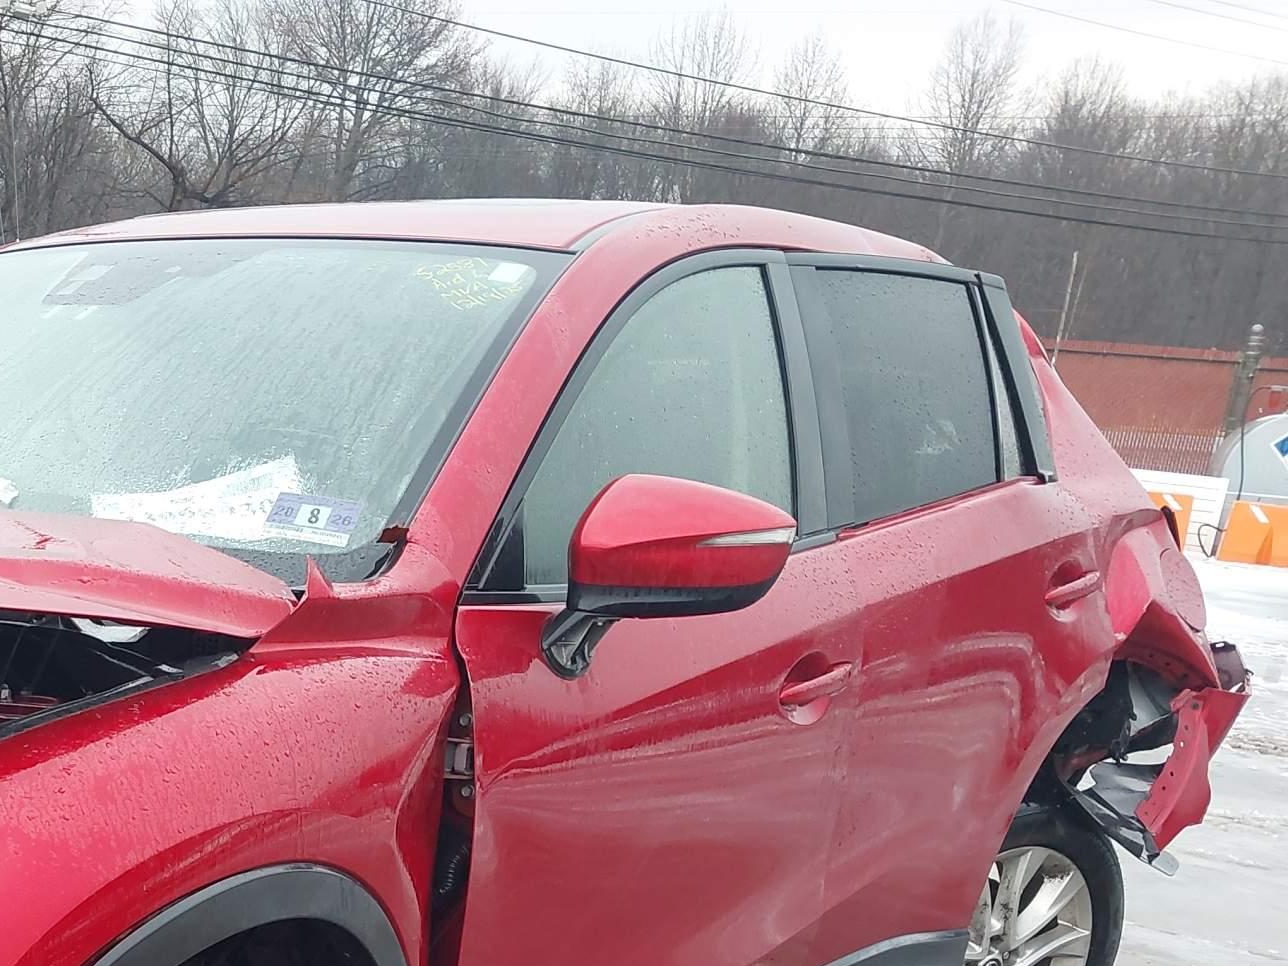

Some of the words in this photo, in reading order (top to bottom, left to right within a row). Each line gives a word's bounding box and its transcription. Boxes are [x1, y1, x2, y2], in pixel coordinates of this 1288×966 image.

[273, 505, 294, 518] 20
[307, 507, 321, 525] 8
[329, 513, 353, 527] 26
